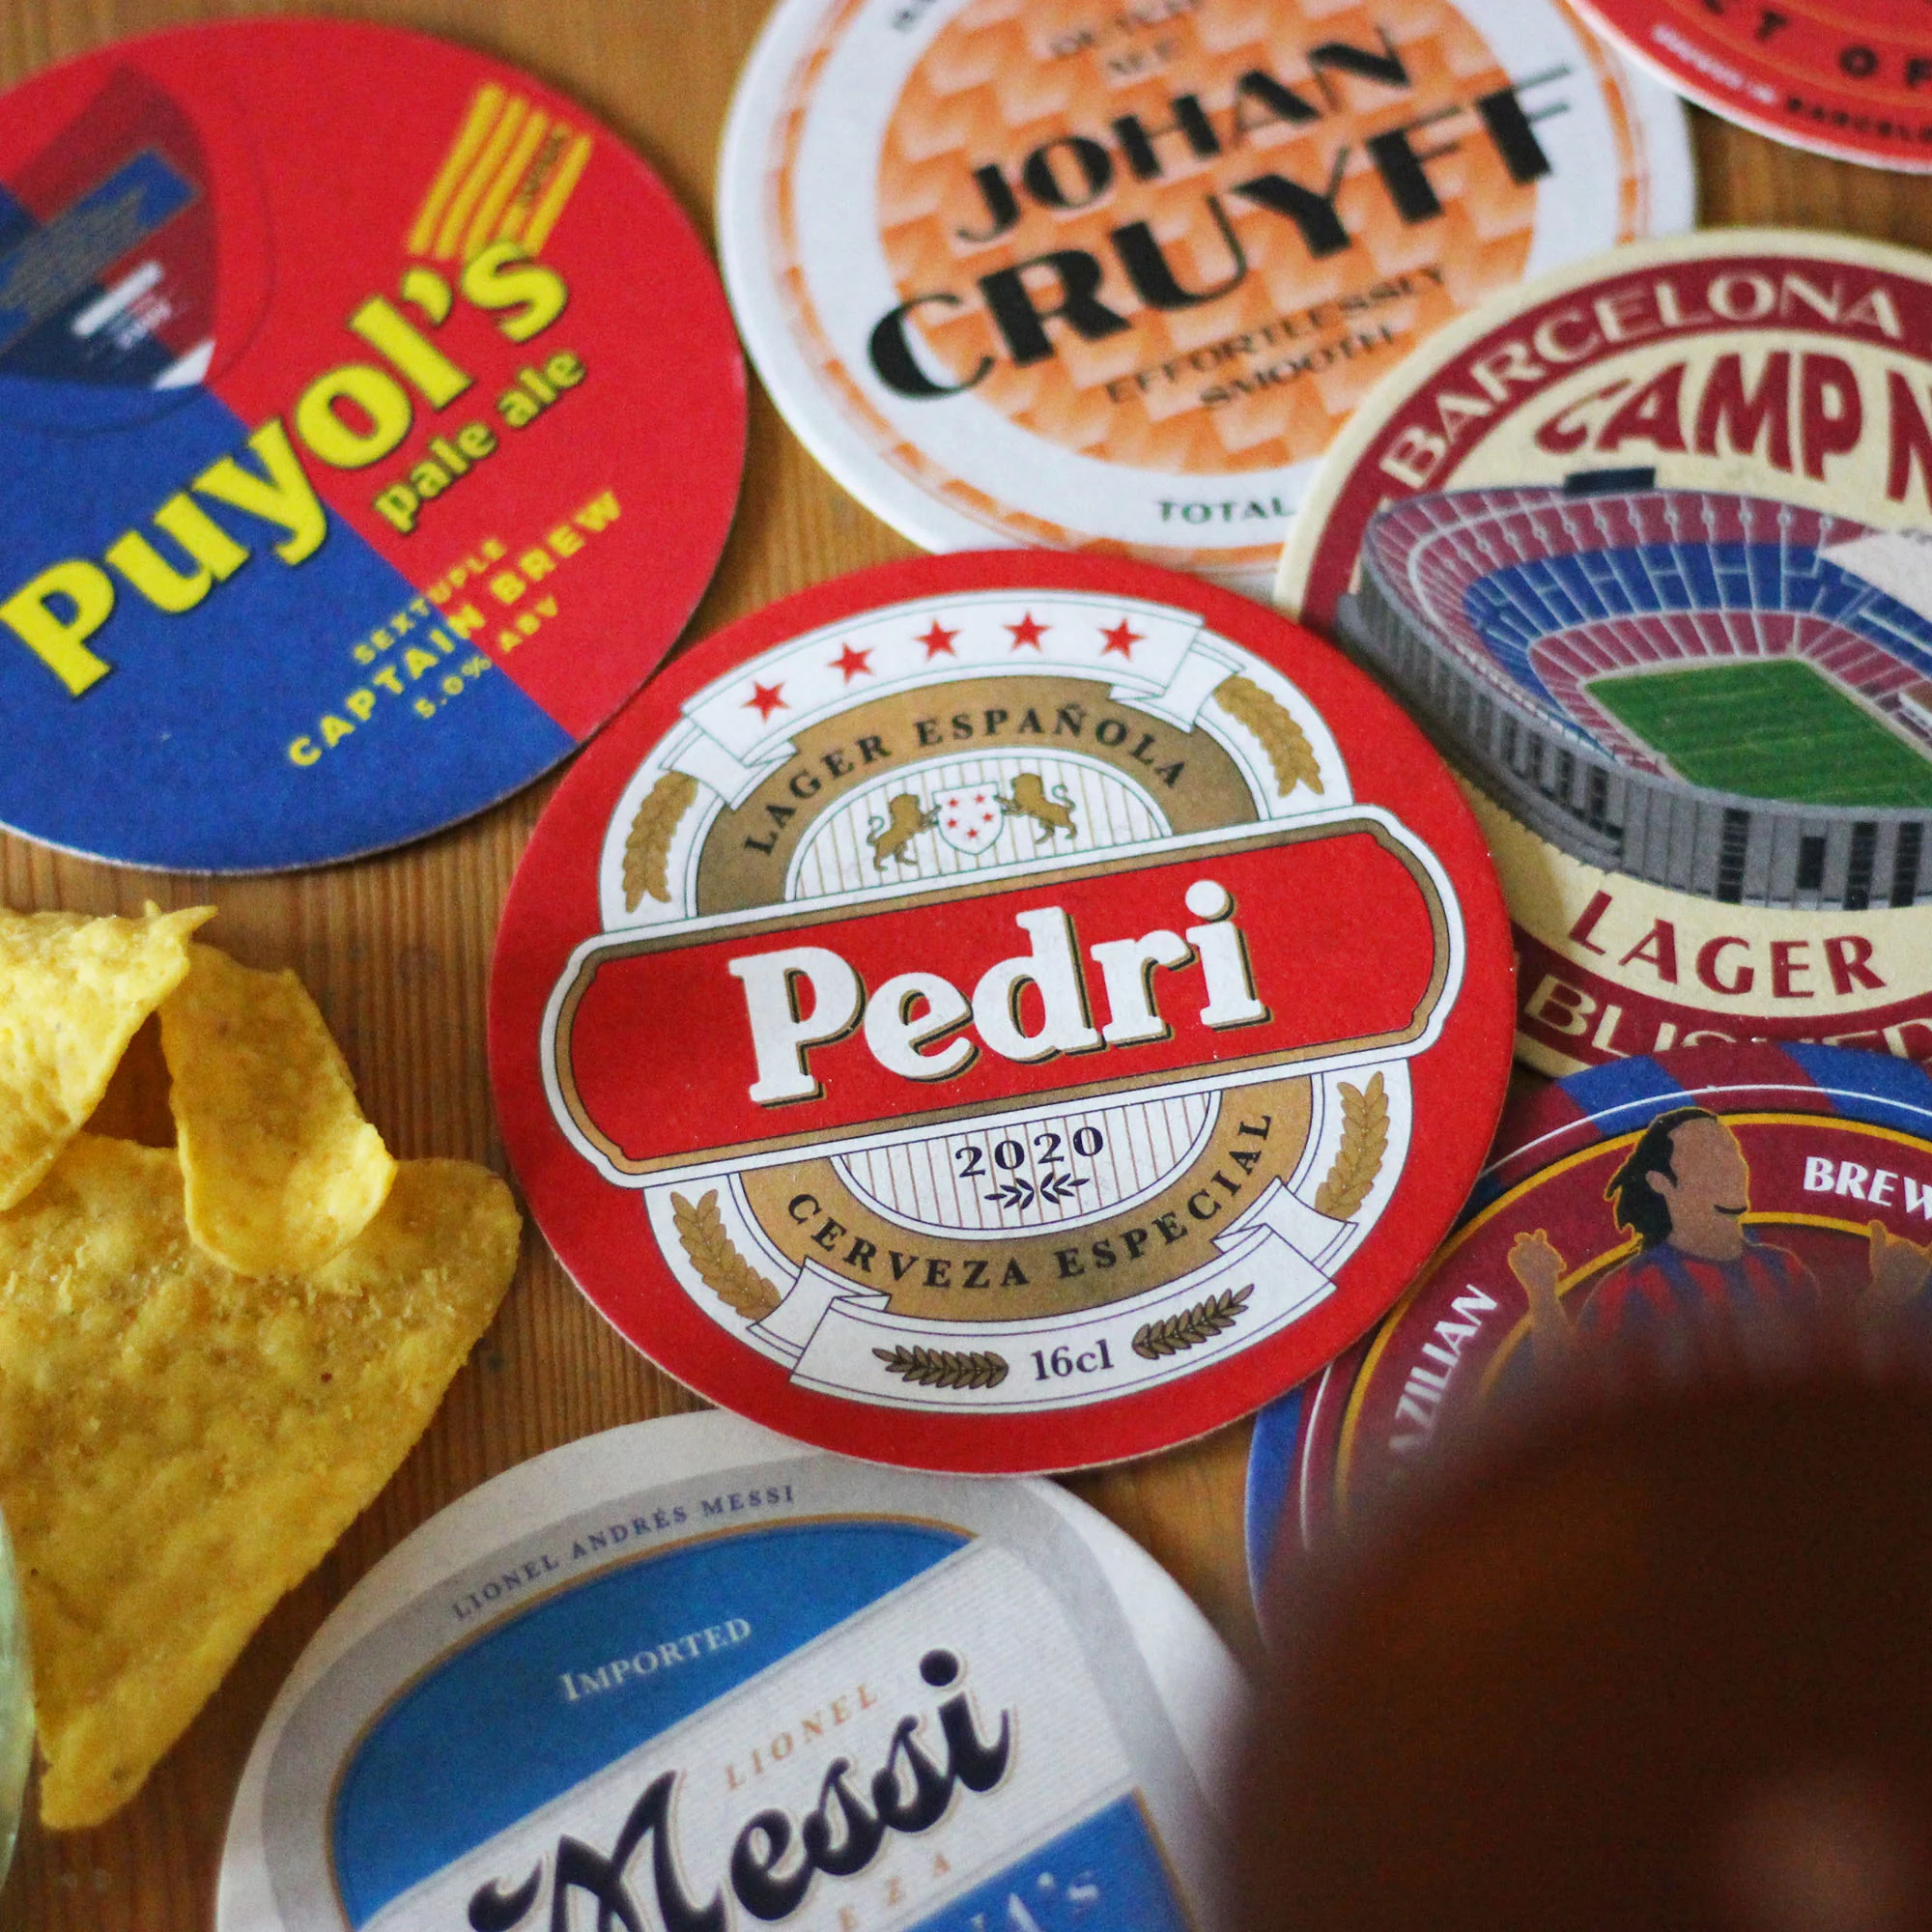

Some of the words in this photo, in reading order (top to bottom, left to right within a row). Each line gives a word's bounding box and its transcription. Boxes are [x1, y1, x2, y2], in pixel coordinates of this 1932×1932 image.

[955, 25, 1411, 245] JOHAN
[868, 64, 1573, 403] CRUYFF
[1199, 325, 1397, 409] SMOOTH
[1378, 272, 1904, 490] BARCELONA
[1534, 349, 1864, 483] CAMP
[373, 421, 498, 536] pale
[498, 350, 587, 431] ale
[1157, 496, 1297, 525] TOTAL
[288, 603, 486, 766] CAPTAIN
[489, 491, 621, 605] BREW
[353, 537, 508, 666] SEXTUPLE
[412, 655, 494, 719] 5.0%
[497, 593, 558, 653] ABV
[745, 735, 890, 858] LAGER
[915, 701, 1192, 789] ESPAÑOLA
[728, 880, 1268, 1107] Pedri
[1569, 889, 1888, 1000] LAGER
[788, 1193, 1030, 1290] CERVEZA
[1056, 1111, 1272, 1279] ESPECIAL
[954, 1125, 1104, 1179] 2020
[1033, 1339, 1114, 1382] 16cl
[450, 1553, 560, 1623] LIONEL
[570, 1503, 689, 1560] ANDRÉS
[701, 1483, 796, 1519] MESSI
[468, 1648, 1010, 1932] Messi
[724, 1683, 879, 1793] LIONEL
